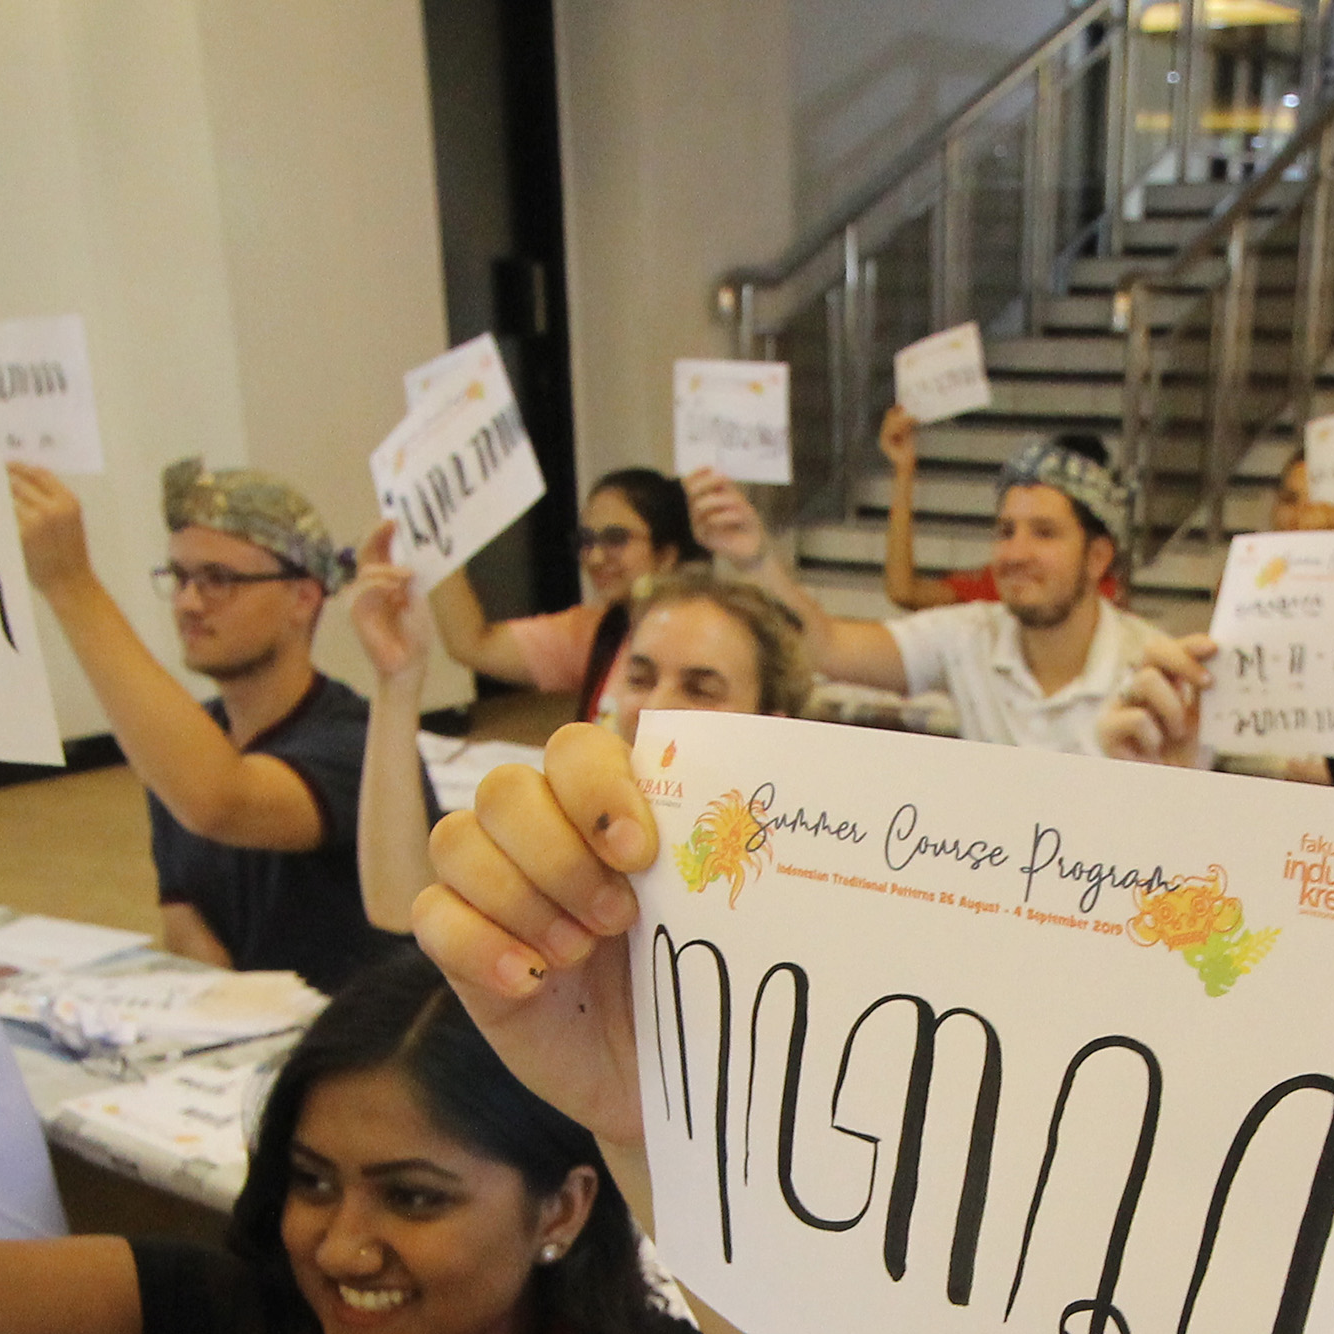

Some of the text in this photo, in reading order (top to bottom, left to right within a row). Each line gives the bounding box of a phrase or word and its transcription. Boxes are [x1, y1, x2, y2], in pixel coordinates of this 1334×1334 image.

[635, 779, 683, 798] BAYA
[745, 783, 1179, 913] Summer Course Program
[776, 862, 829, 882] Indonesian
[832, 872, 887, 895] Traditional
[889, 883, 935, 903] Patterns
[960, 895, 999, 916] August
[1027, 908, 1088, 931] September
[1093, 919, 1124, 936] 2019
